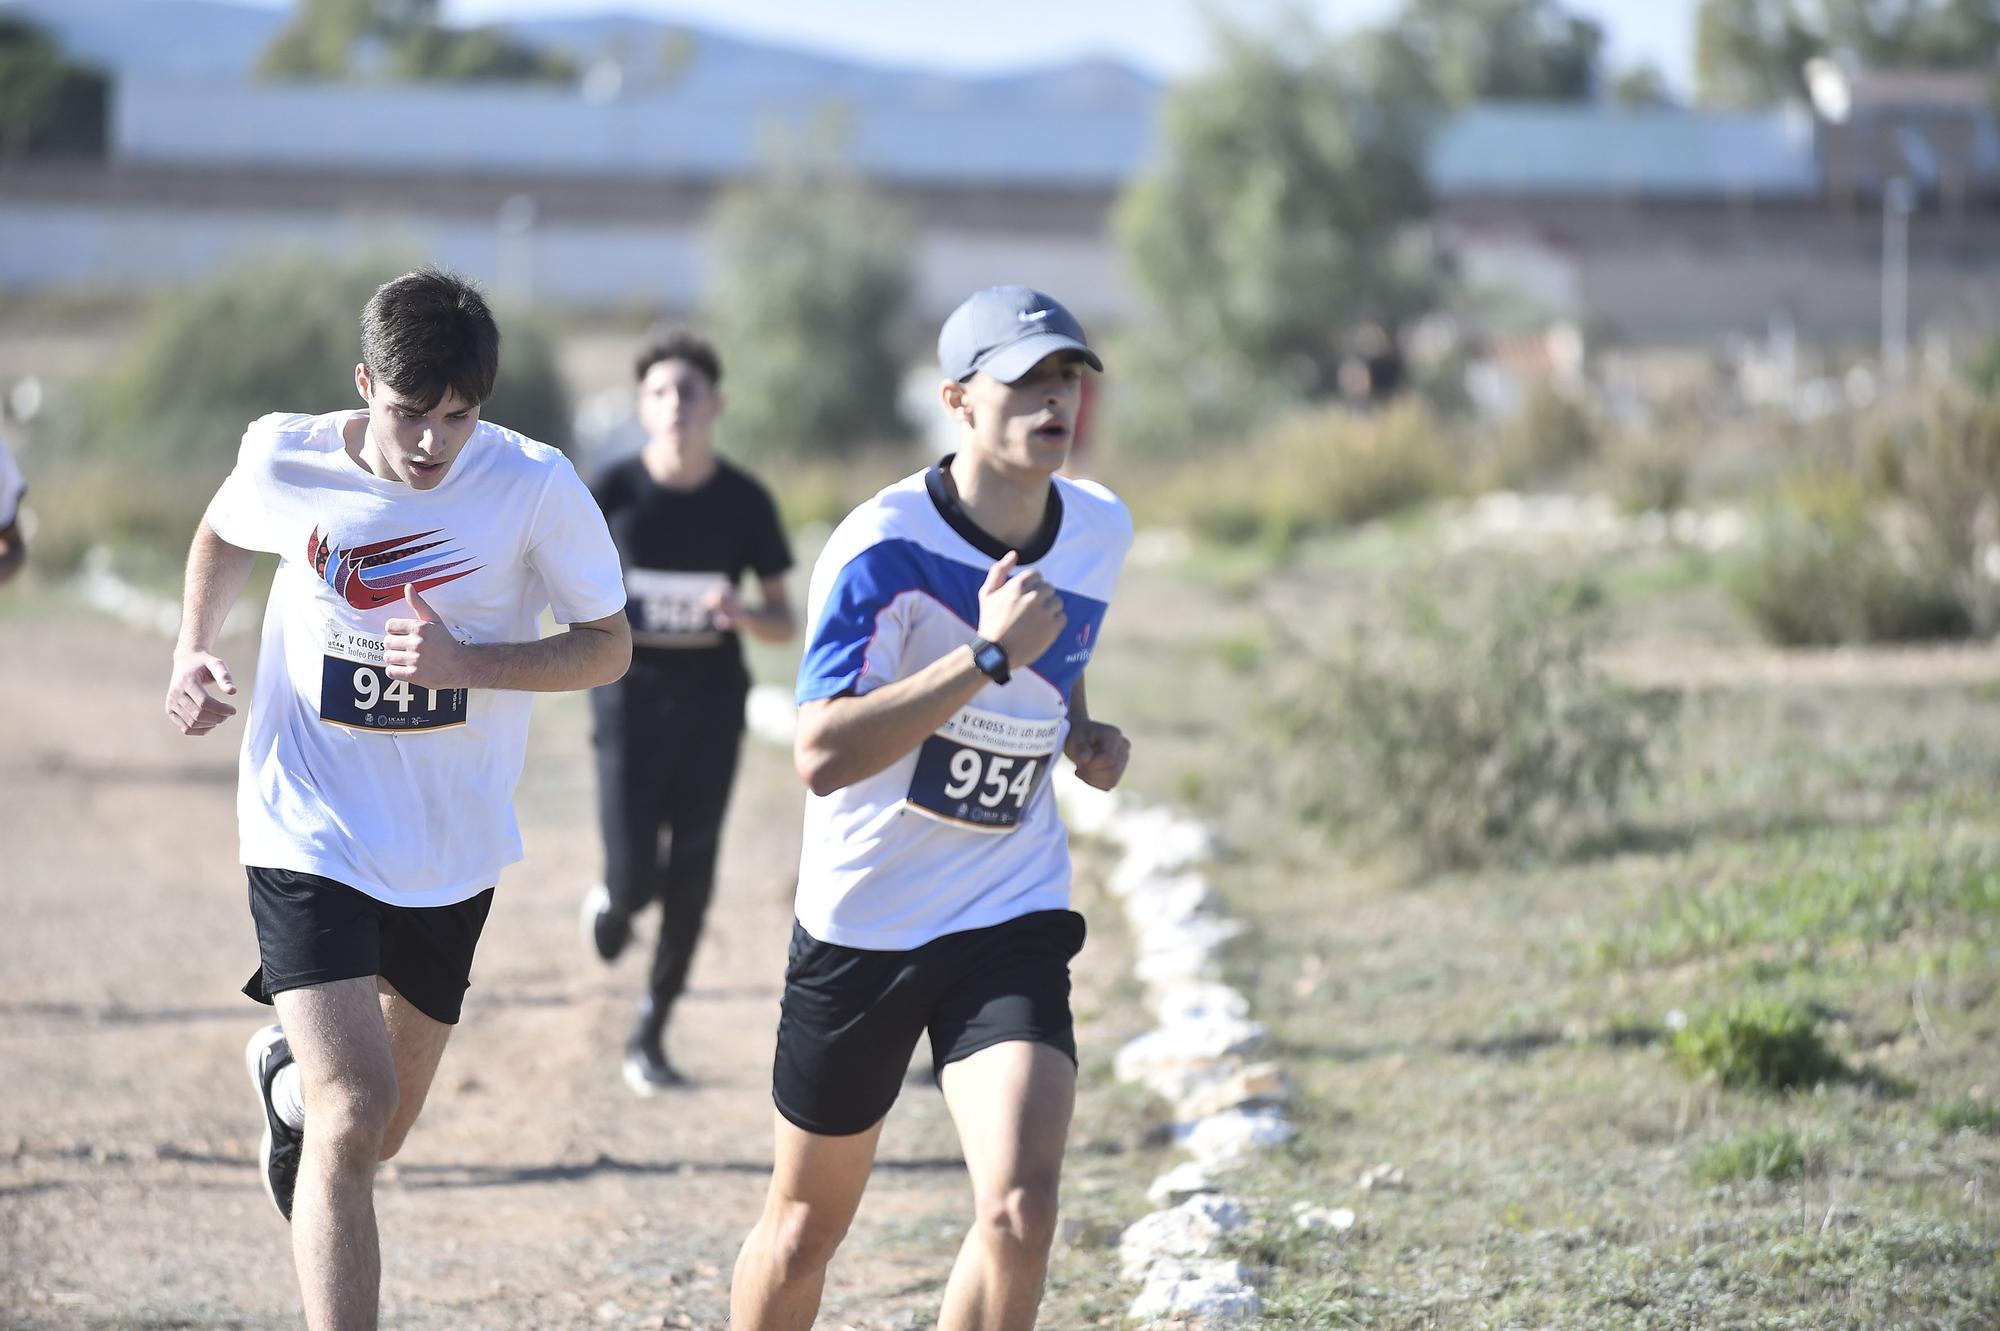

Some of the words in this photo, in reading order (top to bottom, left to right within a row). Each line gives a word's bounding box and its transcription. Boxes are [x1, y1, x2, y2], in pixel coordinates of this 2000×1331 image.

[348, 635, 354, 645] V
[356, 637, 385, 651] CROSS
[347, 646, 367, 659] Trofeo
[972, 717, 1005, 735] CROSS
[944, 748, 1037, 809] 954
